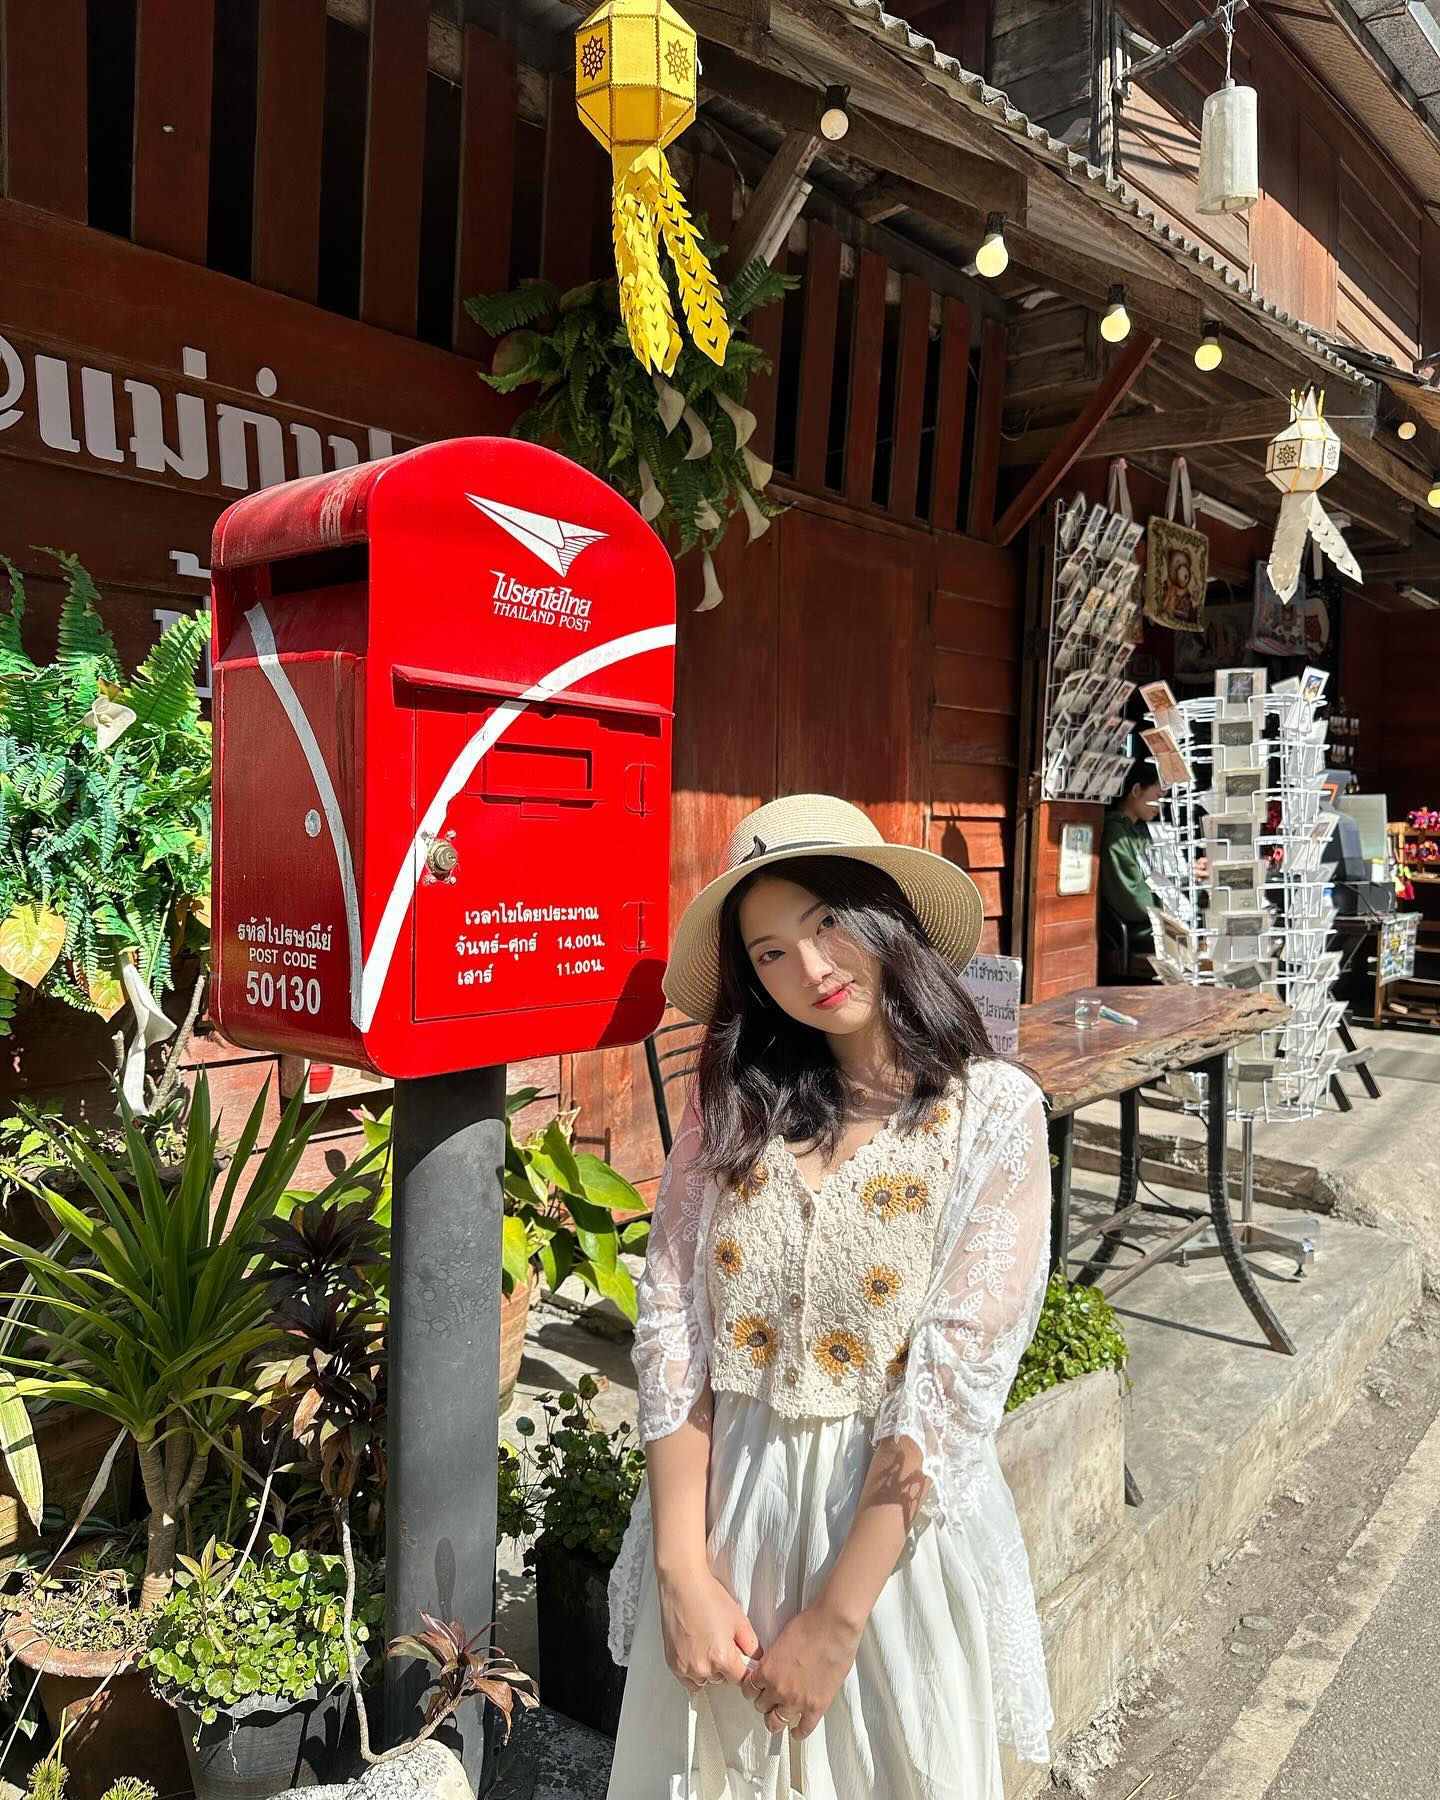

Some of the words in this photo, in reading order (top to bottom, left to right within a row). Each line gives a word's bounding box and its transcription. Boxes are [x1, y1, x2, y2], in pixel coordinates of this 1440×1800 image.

[493, 601, 556, 625] THAILAND
[558, 614, 592, 633] POST
[465, 901, 599, 925] เวลาไขโดยประมาณ
[237, 916, 333, 952] รหัสไปรษณีย์
[249, 947, 279, 964] POST
[282, 950, 317, 970] CODE
[457, 963, 494, 986] เสาร์
[246, 970, 321, 1015] 50130
